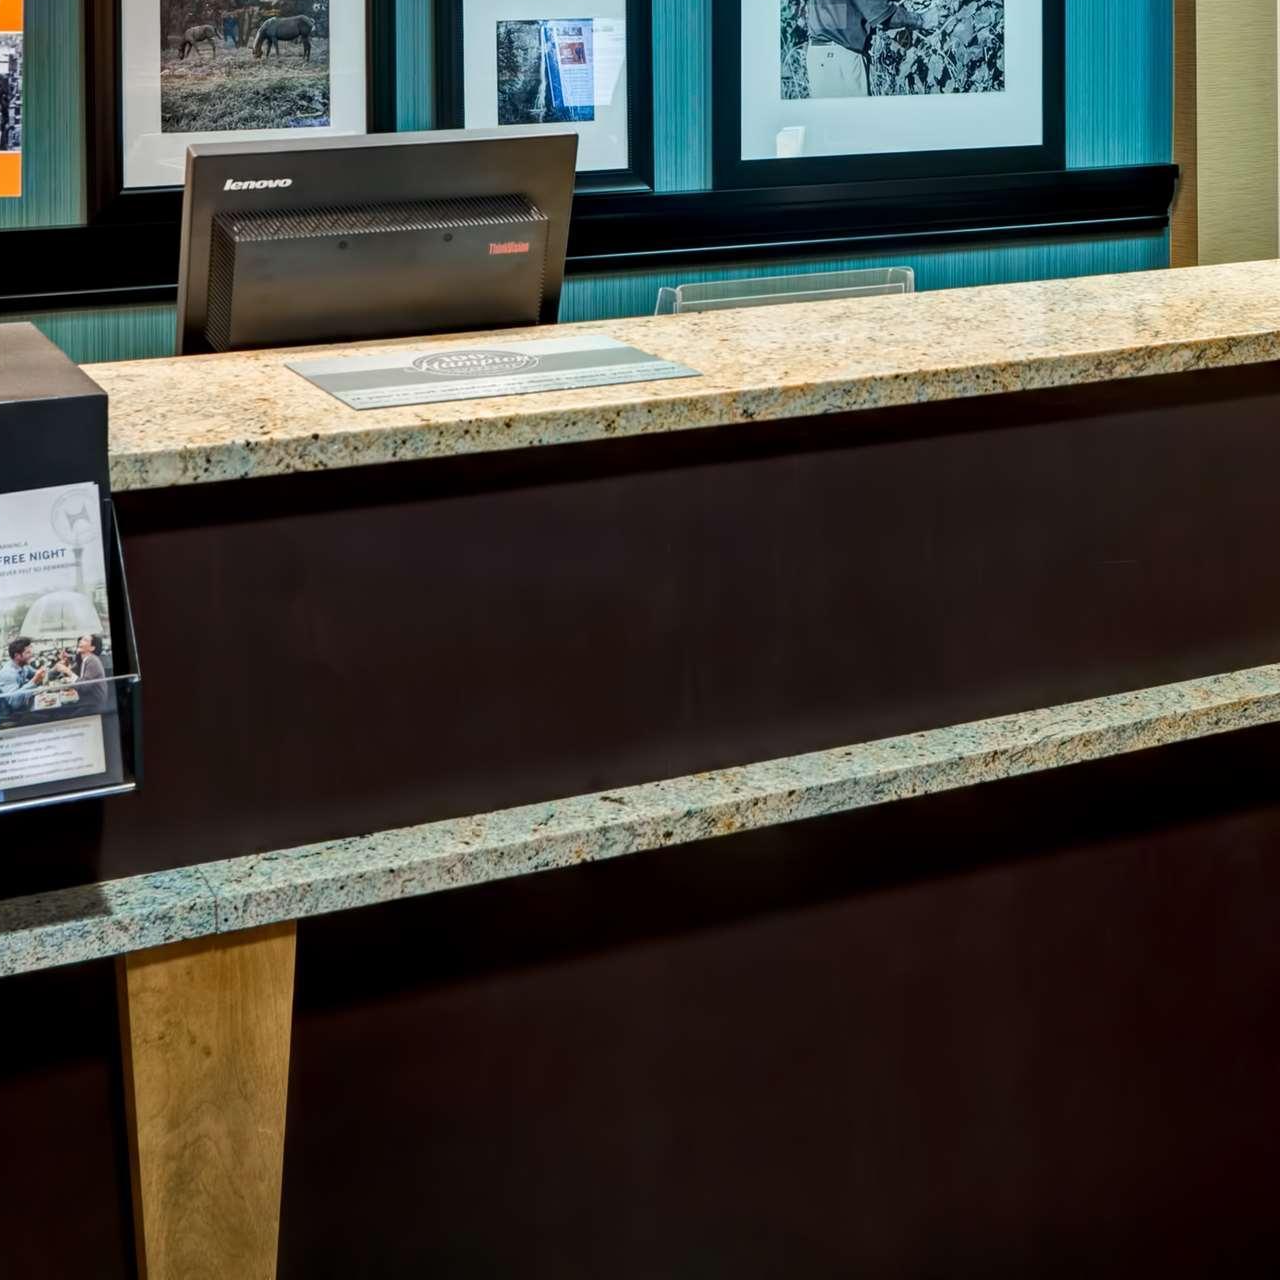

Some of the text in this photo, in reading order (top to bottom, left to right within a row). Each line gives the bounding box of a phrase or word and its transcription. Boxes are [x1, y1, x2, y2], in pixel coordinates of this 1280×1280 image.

[223, 177, 293, 192] lenovo
[29, 548, 66, 561] NIGHT
[18, 567, 32, 575] FELT
